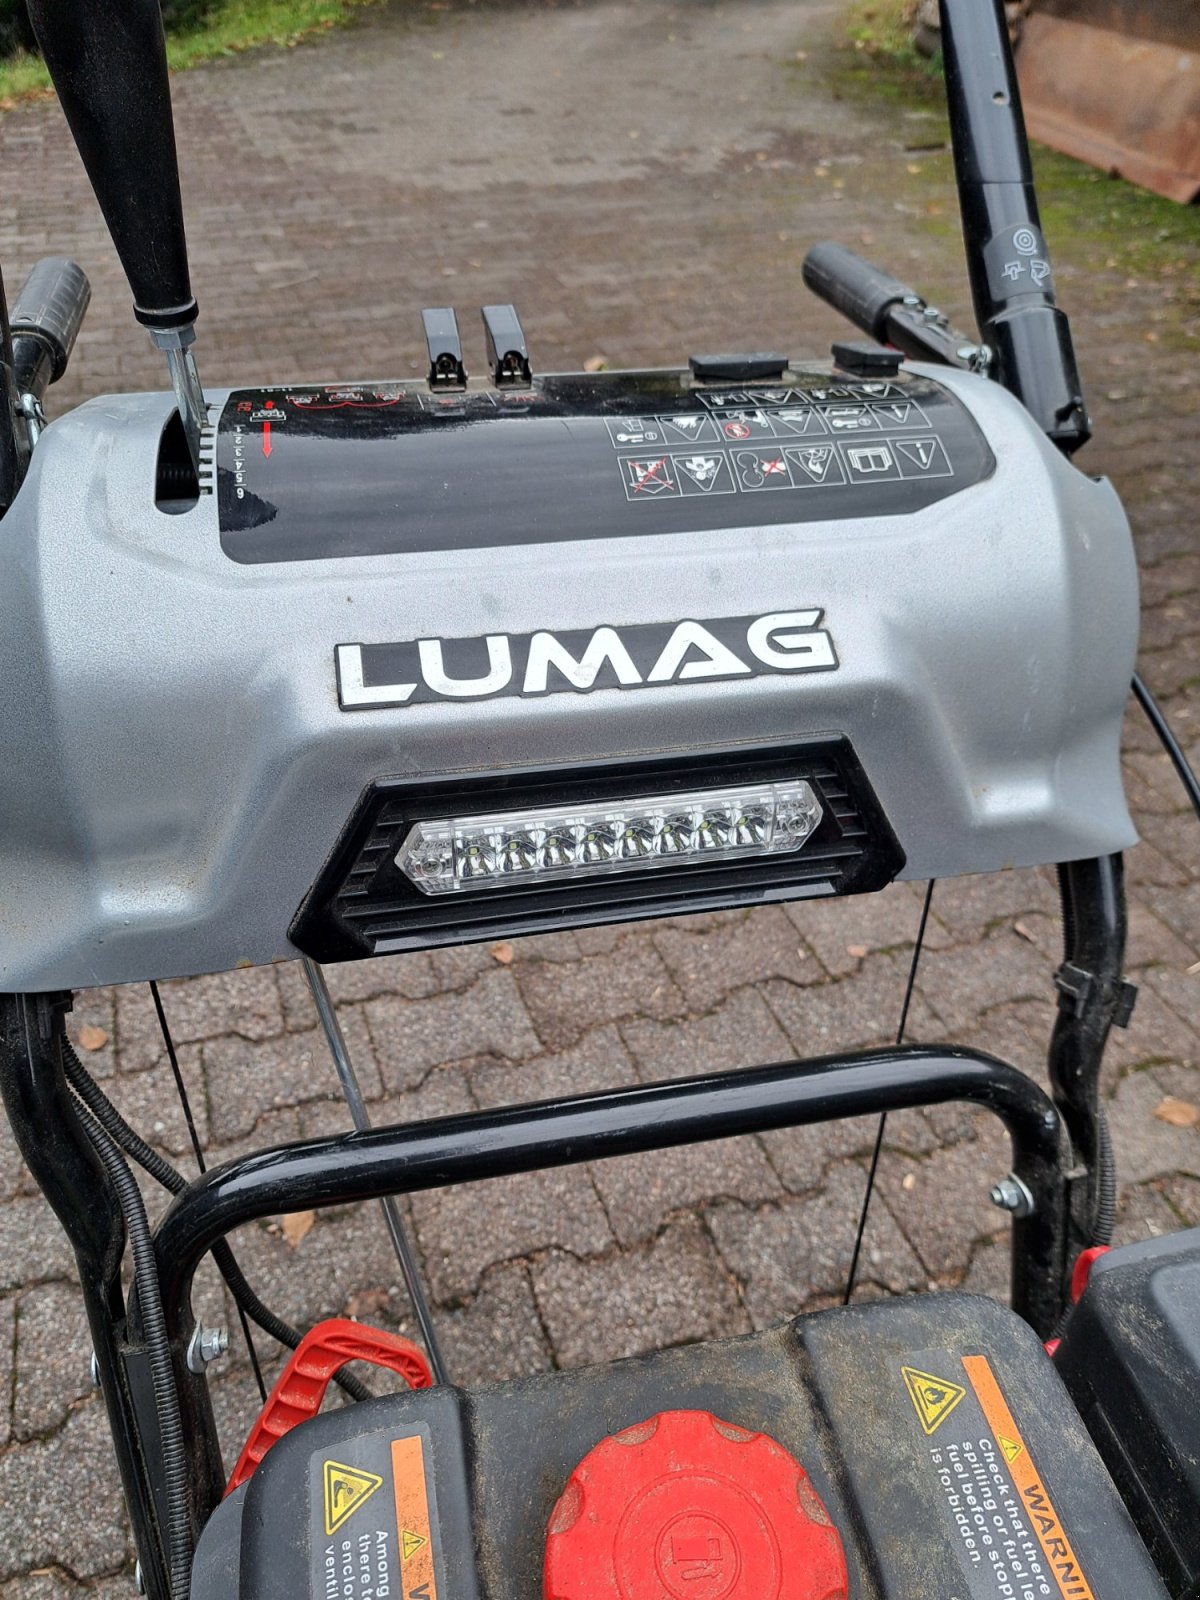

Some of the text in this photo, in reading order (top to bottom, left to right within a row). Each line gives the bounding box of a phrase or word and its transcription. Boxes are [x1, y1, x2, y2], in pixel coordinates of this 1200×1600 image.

[235, 461, 243, 470] 4
[235, 473, 243, 483] 5
[336, 607, 838, 706] LUMAG
[358, 1534, 371, 1584] there
[930, 1448, 981, 1569] is forbidden.
[946, 1444, 1017, 1600] fuel before stop
[962, 1441, 997, 1511] spilling
[993, 1515, 1008, 1535] or
[1003, 1539, 1029, 1578] fuel
[979, 1439, 1050, 1594] Check that there
[1023, 1484, 1089, 1600] WARNI
[376, 1530, 390, 1597] Among
